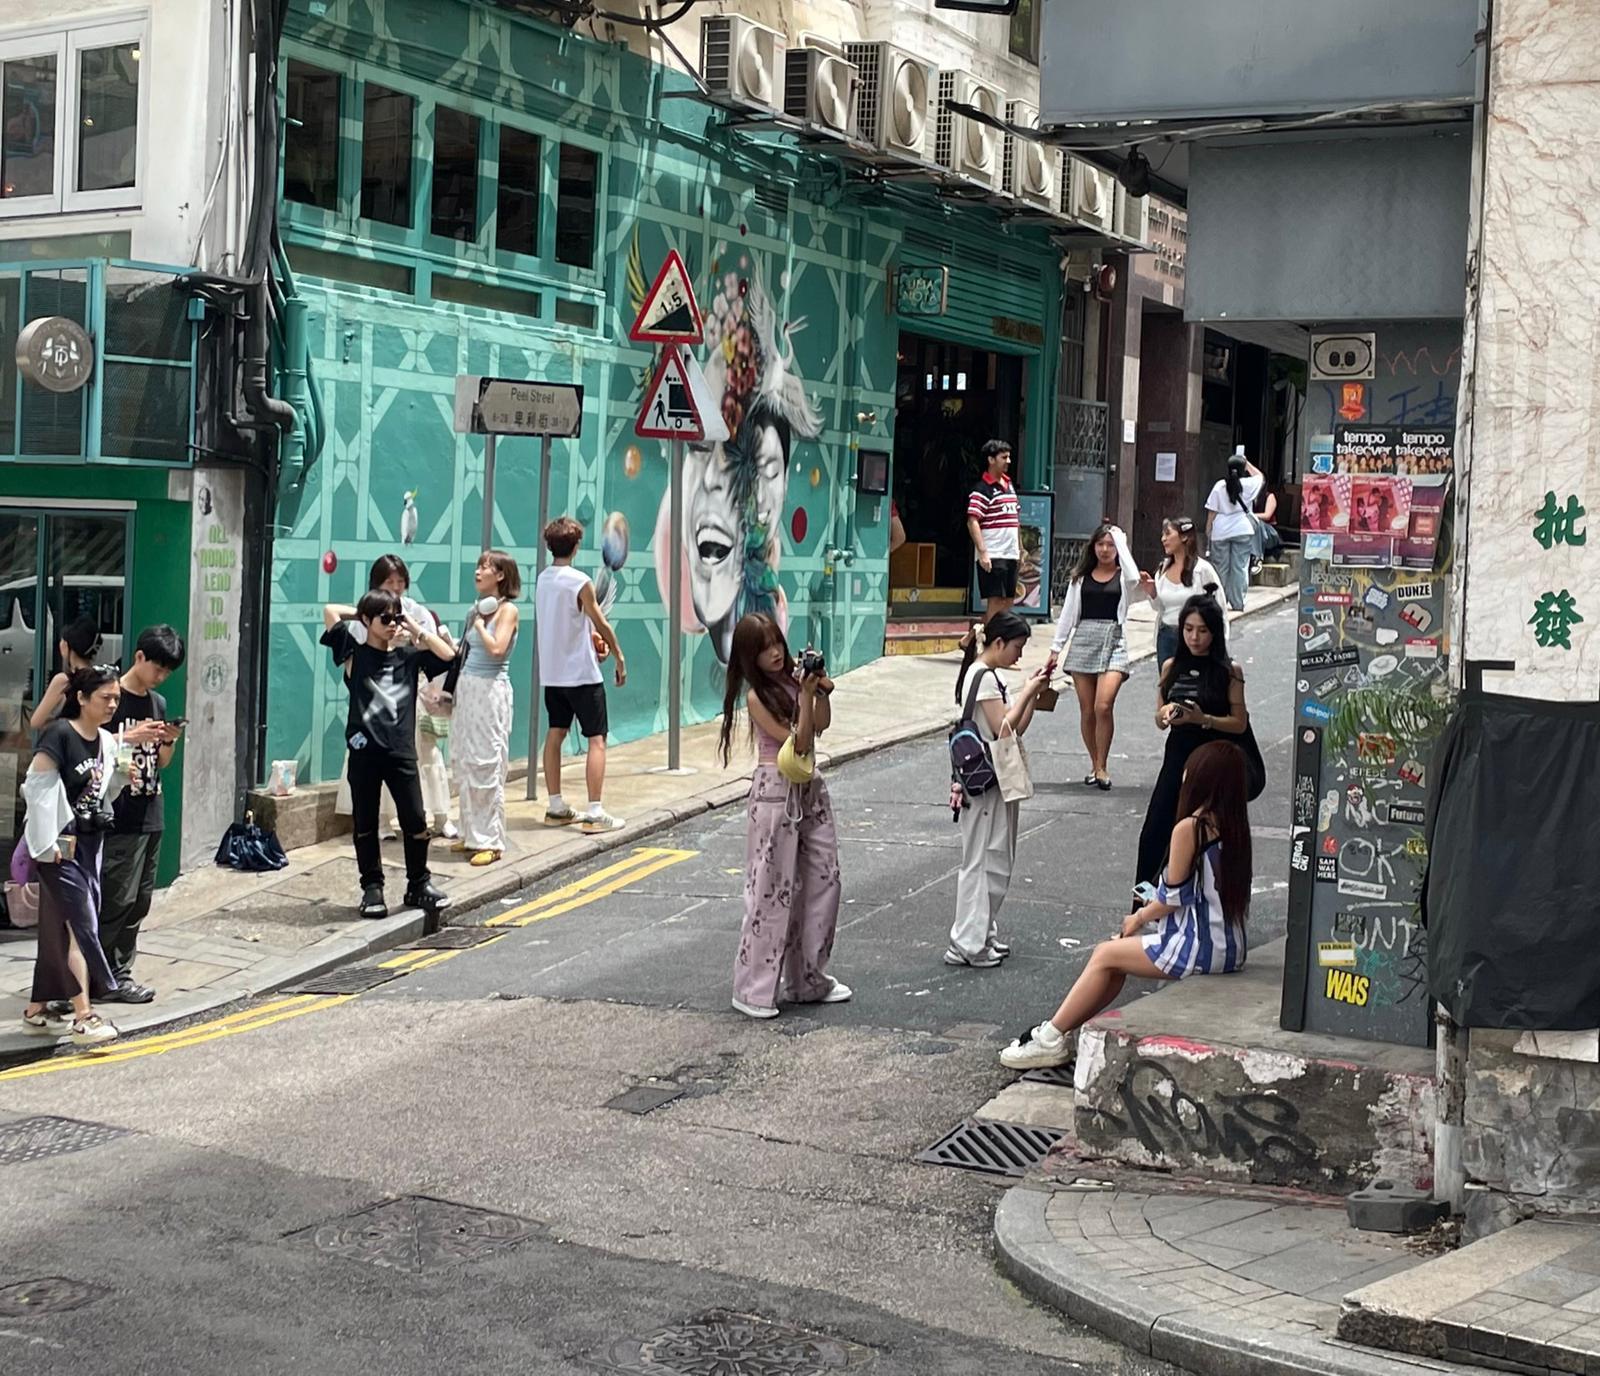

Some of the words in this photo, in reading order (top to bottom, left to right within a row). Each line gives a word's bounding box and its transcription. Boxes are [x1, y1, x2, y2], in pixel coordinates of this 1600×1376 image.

[908, 278, 934, 289] UMA
[660, 291, 682, 314] 1:5
[510, 387, 528, 401] Peel
[530, 391, 555, 404] Street
[514, 410, 548, 429] 卑利街
[1343, 431, 1386, 446] tempo
[1402, 432, 1445, 447] tempo
[1528, 489, 1587, 650] 批發
[204, 572, 231, 592] LEAD
[1397, 584, 1431, 598] DUNZE
[209, 597, 224, 616] TO
[1390, 808, 1424, 823] Future
[1326, 968, 1370, 1006] WAIS
